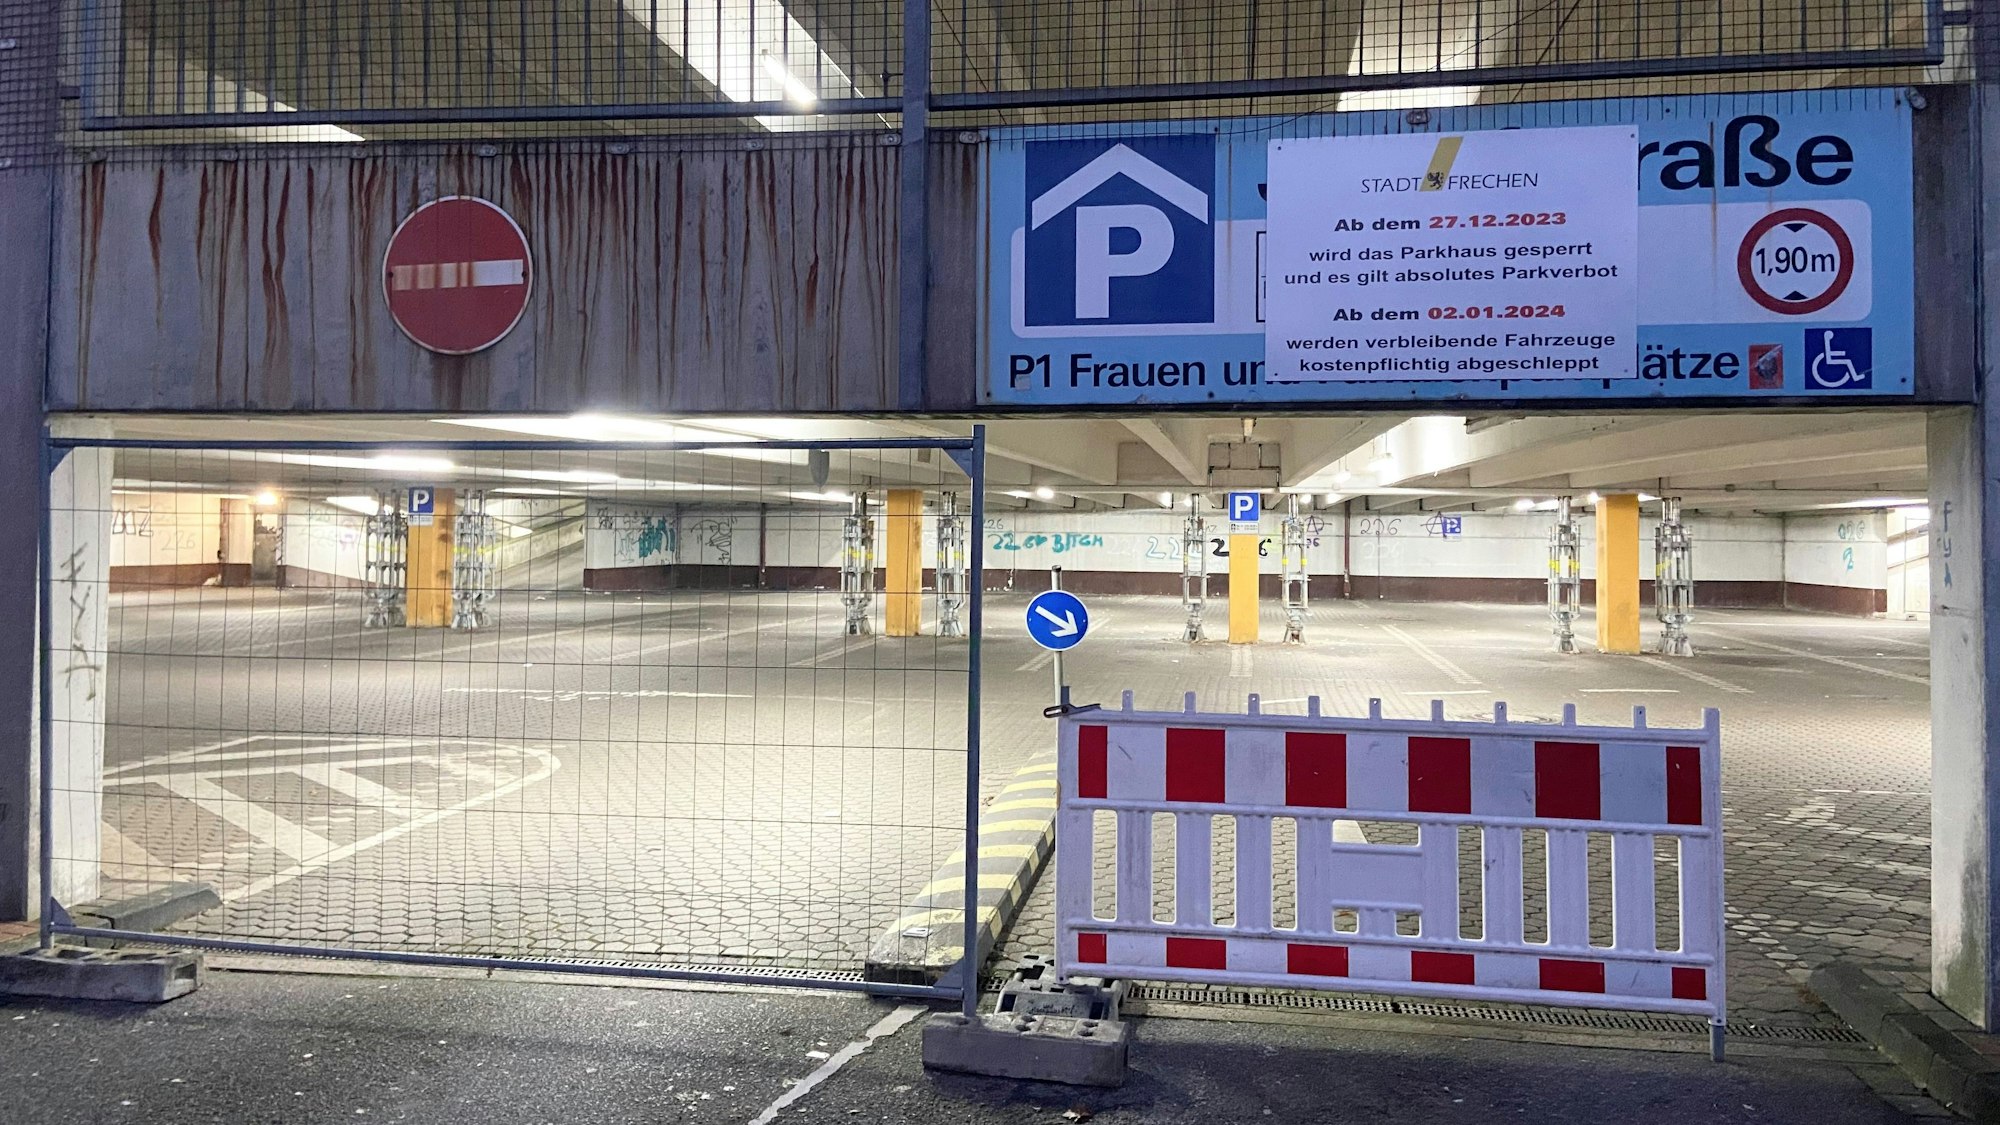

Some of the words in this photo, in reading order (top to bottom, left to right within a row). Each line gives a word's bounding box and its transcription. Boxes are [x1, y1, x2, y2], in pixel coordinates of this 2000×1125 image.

[1638, 115, 1853, 191] raße
[1361, 177, 1422, 194] STADT
[1448, 172, 1539, 190] FRECHEN
[1334, 218, 1364, 232] Ab
[1372, 217, 1421, 230] dem
[1429, 212, 1567, 229] 27.12.2023
[1076, 203, 1176, 319] P
[1309, 249, 1351, 261] wird
[1358, 247, 1393, 260] das
[1401, 245, 1497, 259] Parkhaus
[1504, 242, 1592, 260] gesperrt
[1755, 246, 1835, 277] 1,90m
[1285, 271, 1321, 284] und
[1328, 273, 1350, 283] es
[1357, 270, 1389, 286] gilt
[1395, 268, 1495, 282] absolutes
[1502, 264, 1618, 280] Parkverbot
[1333, 308, 1363, 321] Ab
[1371, 308, 1419, 320] dem
[1428, 305, 1566, 320] 02.01.2024
[1287, 336, 1358, 349] werden
[1365, 334, 1498, 348] verbleibende
[1505, 333, 1615, 349] Fahrzeuge
[1010, 354, 1051, 387] P1
[1070, 353, 1206, 387] Frauen
[1223, 360, 1265, 386] un
[1637, 344, 1739, 380] ätze
[1300, 358, 1450, 373] kostenpflichtig
[1457, 356, 1599, 372] abgeschleppt
[413, 489, 430, 512] P
[1234, 495, 1254, 520] P
[984, 518, 1004, 530] 26
[1211, 538, 1272, 557] 26
